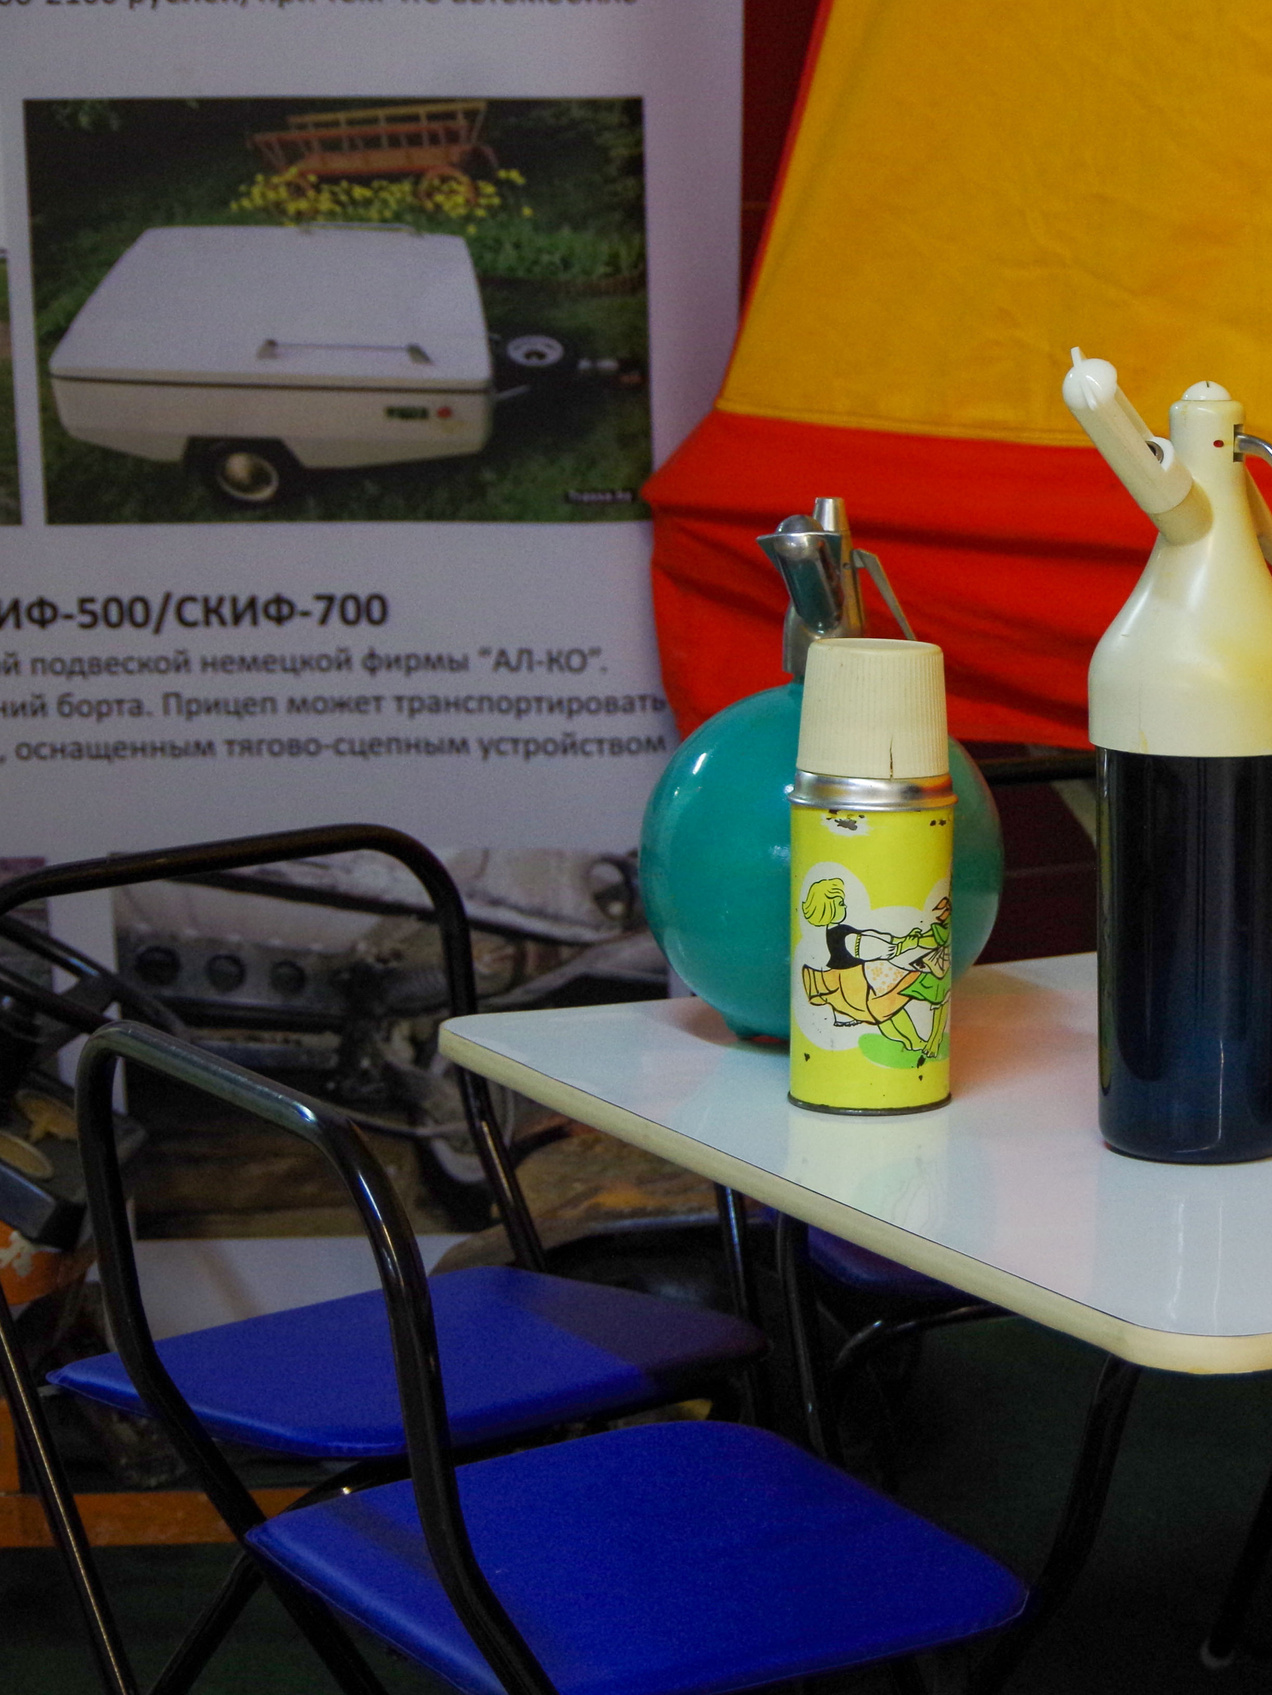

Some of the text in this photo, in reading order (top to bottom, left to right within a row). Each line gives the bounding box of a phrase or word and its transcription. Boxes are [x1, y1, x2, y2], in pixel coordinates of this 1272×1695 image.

[31, 650, 191, 679] подвеской
[200, 648, 352, 676] немецкой
[361, 647, 468, 676] фирмы
[57, 692, 152, 722] борта.
[162, 692, 277, 720] Прицеп
[287, 694, 384, 716] может
[393, 693, 667, 719] транспортировать
[15, 732, 667, 763] оснащенным тягово-сцепным устройством
